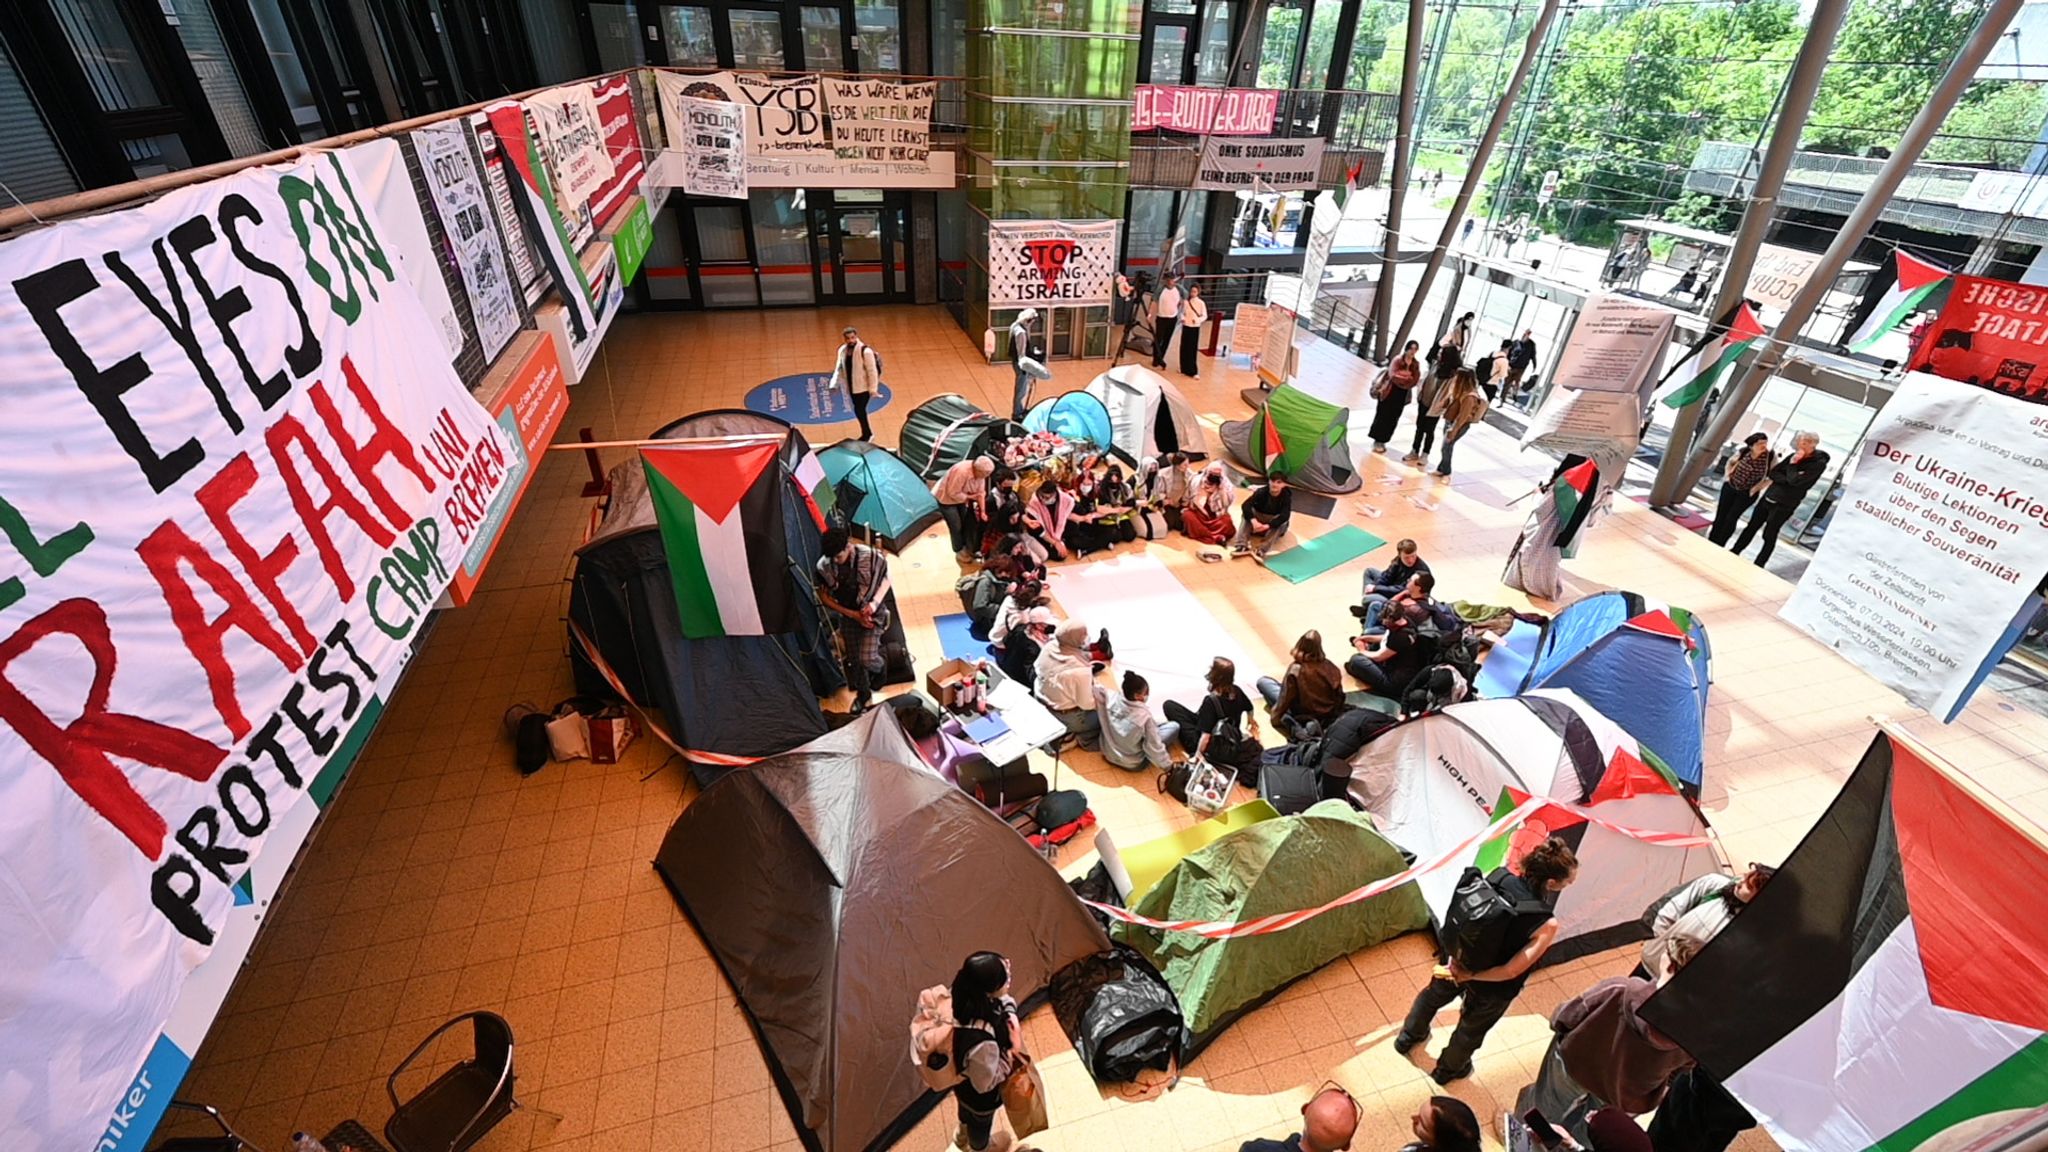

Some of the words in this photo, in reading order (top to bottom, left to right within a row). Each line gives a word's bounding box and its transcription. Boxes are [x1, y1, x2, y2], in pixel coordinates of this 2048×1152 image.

[834, 83, 861, 97] WAS
[866, 82, 902, 100] WÄRE
[905, 86, 935, 101] WENN
[738, 85, 819, 137] YSB
[830, 105, 841, 120] ES
[844, 105, 858, 120] DIE
[861, 105, 887, 120] WELT
[890, 104, 909, 120] FÜR
[913, 106, 929, 120] DIE
[837, 127, 850, 139] DU
[855, 128, 885, 142] HEUTE
[891, 129, 929, 147] LERNST
[1219, 145, 1242, 157] OHNE
[1246, 145, 1305, 158] SOZIALISMUS
[805, 163, 836, 174] Kultur
[1201, 170, 1225, 182] KEINE
[1275, 172, 1291, 183] DER
[1293, 171, 1314, 183] FRAU
[1019, 244, 1083, 266] STOP
[1019, 266, 1082, 281] ARMING
[1017, 283, 1082, 300] ISRAEL
[12, 193, 323, 494] EYES
[278, 150, 395, 326] ON
[421, 407, 470, 481] UNI
[1873, 441, 1912, 466] Der
[444, 425, 506, 545] BREMEN
[1892, 471, 1940, 501] Blutige
[1942, 493, 2020, 535] Lektionen
[1889, 492, 1920, 513] über
[1921, 508, 1947, 527] den
[1949, 519, 1998, 551] Segen
[1854, 499, 1922, 537] staatlicher
[1922, 530, 2022, 585] Souveränität
[0, 353, 437, 861] RAFAH
[1928, 588, 1945, 602] von
[151, 619, 378, 947] PROTEST
[366, 516, 450, 640] CAMP
[1438, 754, 1468, 788] HIGH
[1467, 787, 1494, 817] PEA
